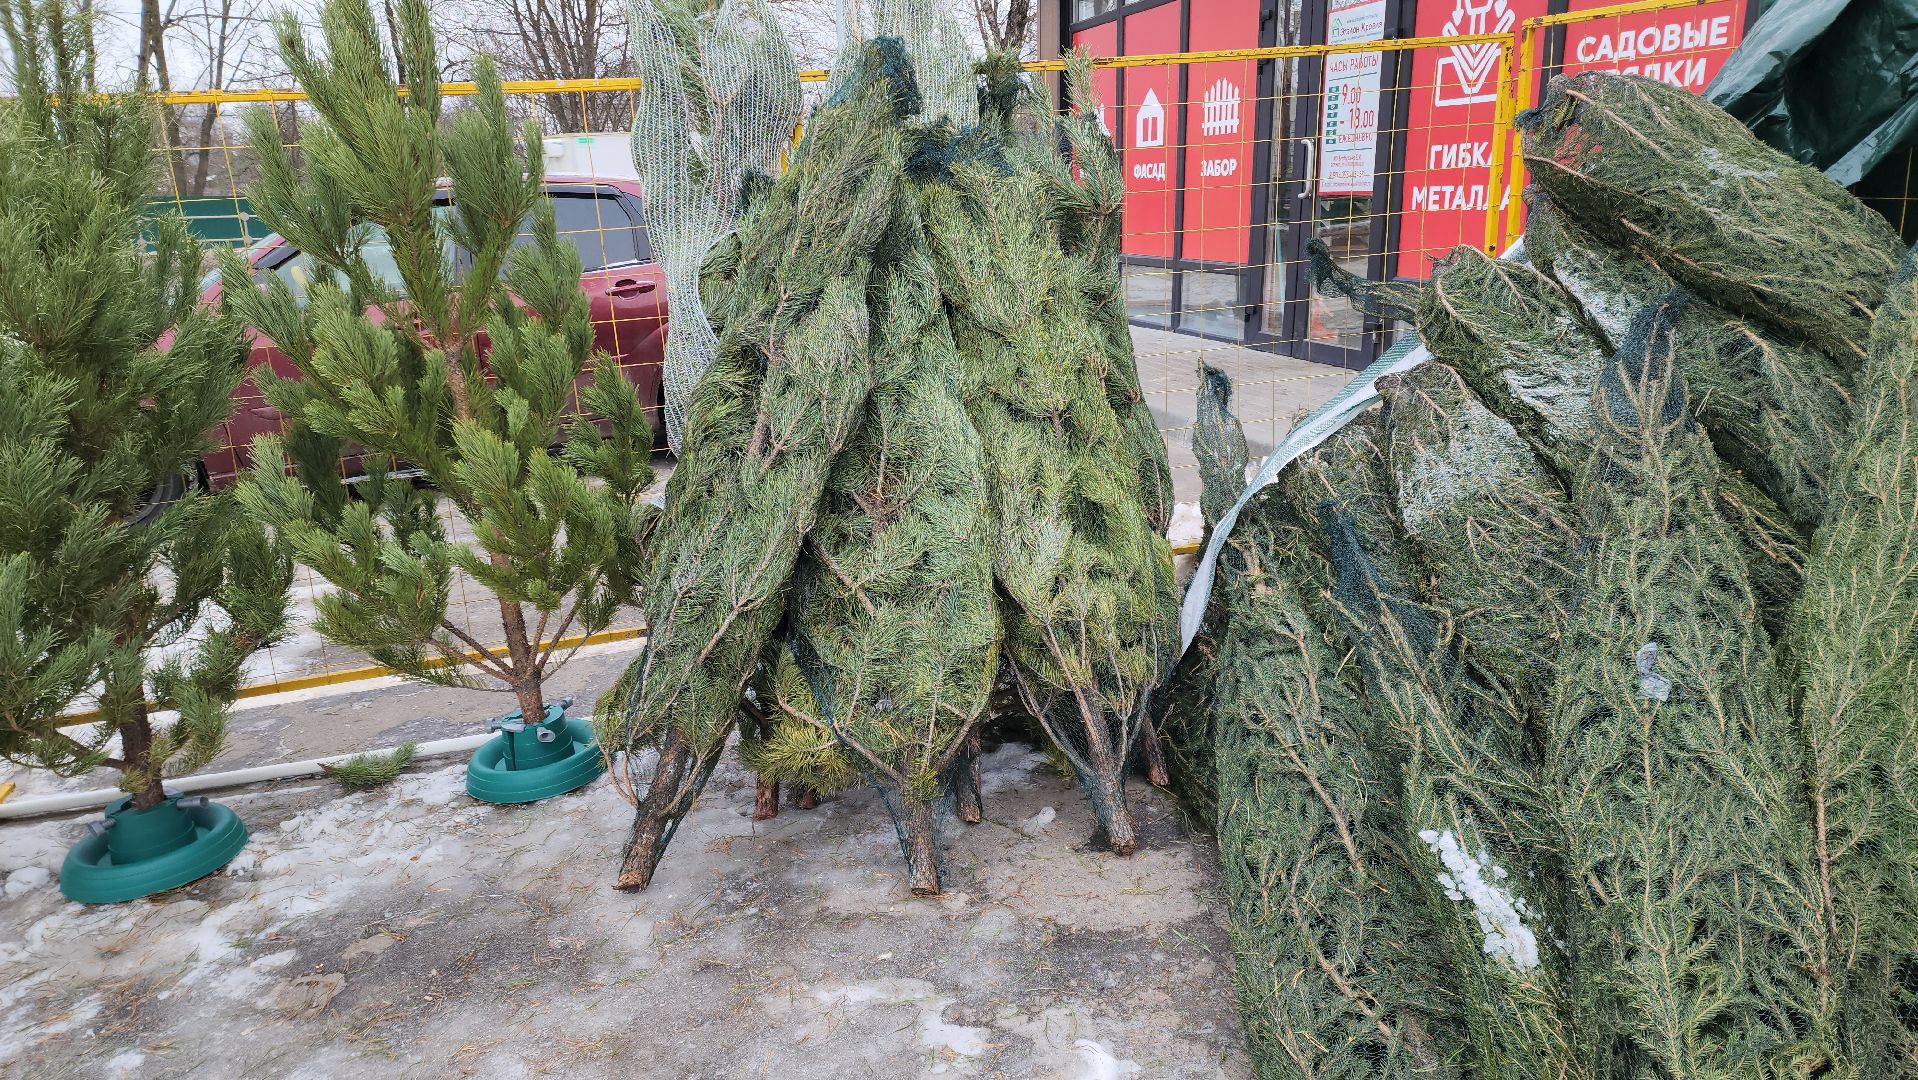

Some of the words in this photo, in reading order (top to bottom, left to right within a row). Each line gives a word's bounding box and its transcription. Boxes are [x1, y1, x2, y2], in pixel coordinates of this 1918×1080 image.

[1576, 15, 1731, 63] САДОВЫЕ
[1330, 60, 1348, 72] ЧАСЫ
[1350, 55, 1378, 70] РАБОТЫ
[1582, 57, 1707, 87] ДКИ
[1342, 84, 1361, 105] 9.00
[1133, 162, 1166, 182] ФАСАД
[1200, 158, 1238, 177] ЗАБОР
